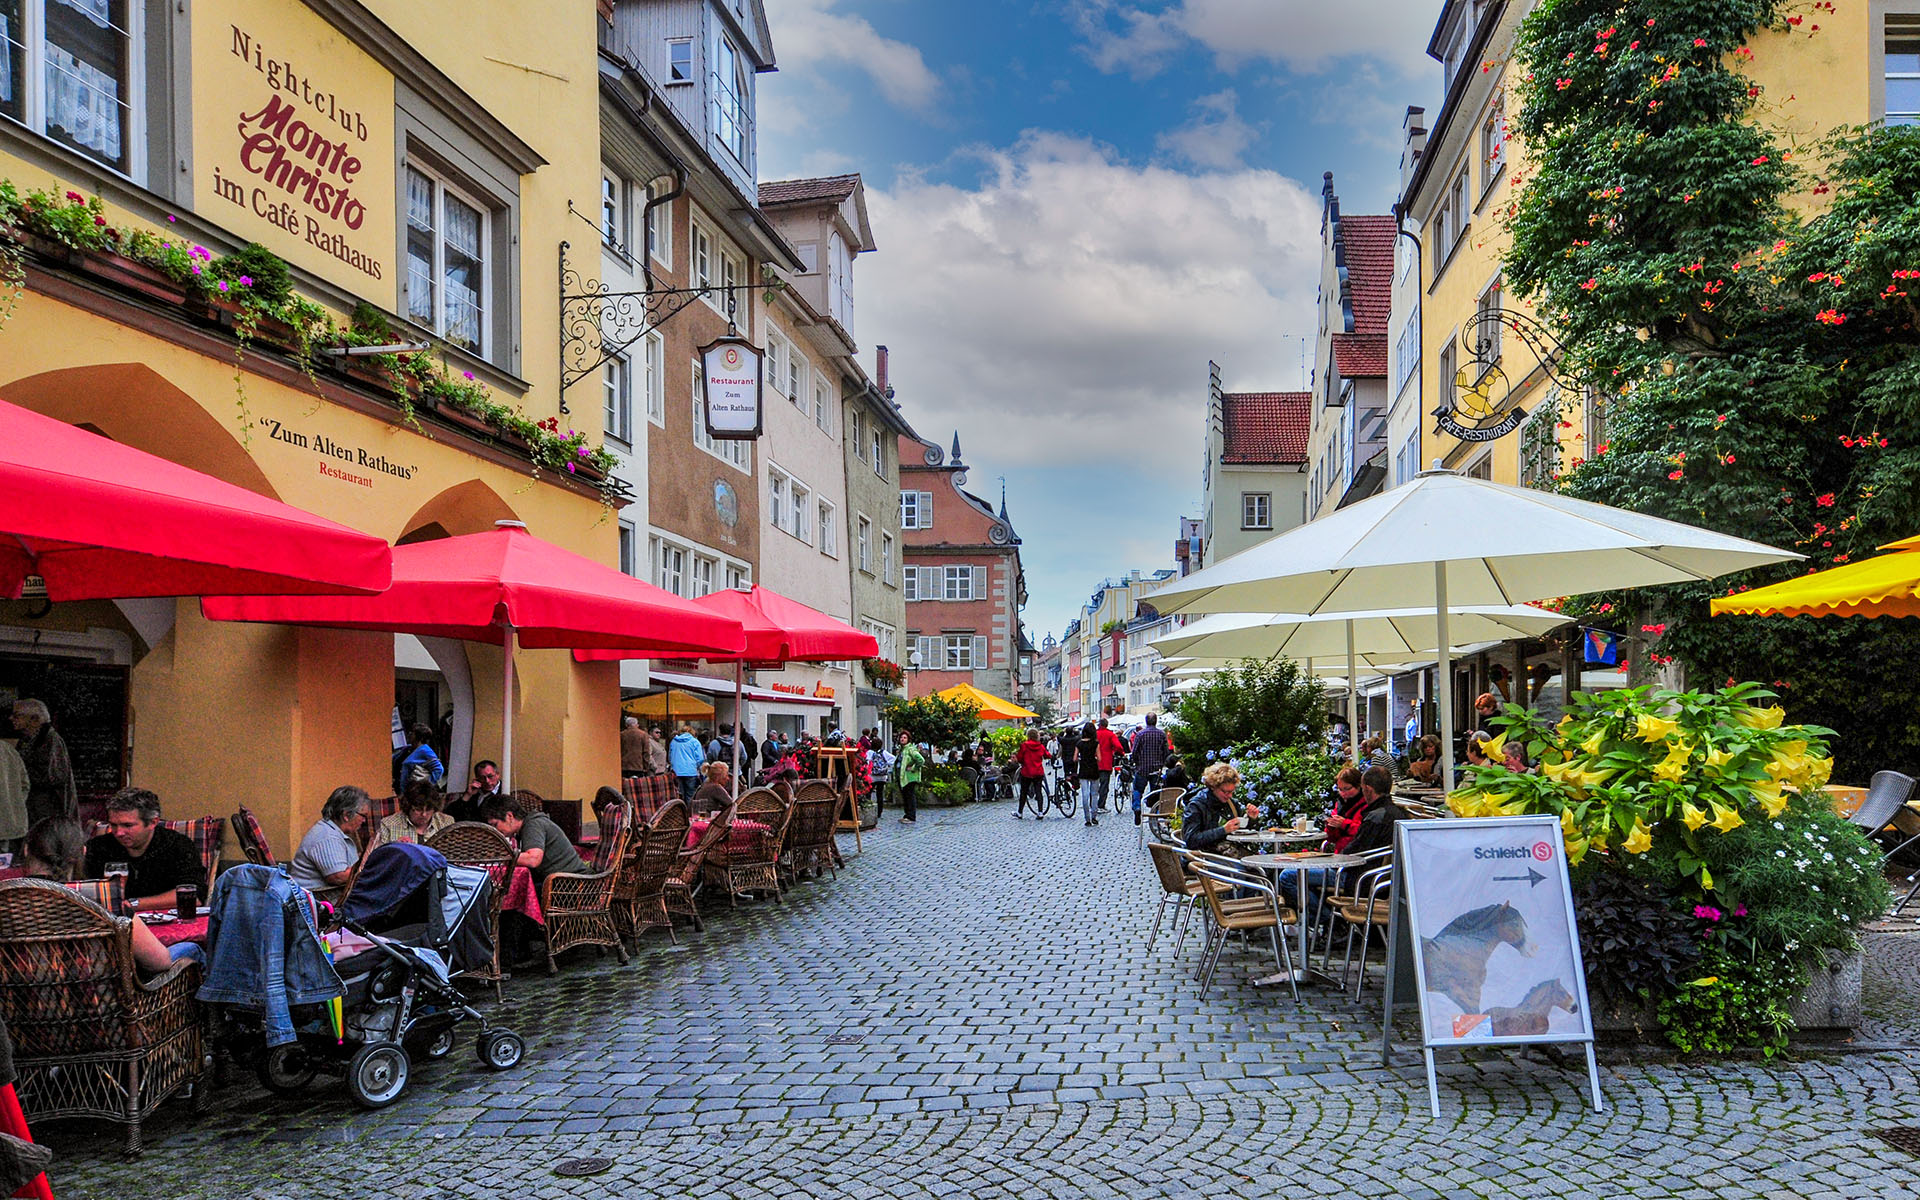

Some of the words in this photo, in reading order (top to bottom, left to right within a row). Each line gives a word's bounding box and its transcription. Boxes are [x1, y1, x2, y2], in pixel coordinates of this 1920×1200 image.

[231, 23, 368, 142] Nightclub
[239, 94, 362, 184] Monte
[237, 122, 367, 231] Christo
[213, 166, 246, 209] im
[251, 187, 300, 236] Café
[304, 215, 382, 281] Rathaus
[711, 403, 728, 411] Alten
[730, 404, 755, 412] Rathaus
[312, 434, 353, 462] Alten
[319, 461, 373, 489] Restaurant
[1473, 846, 1532, 860] Schleich
